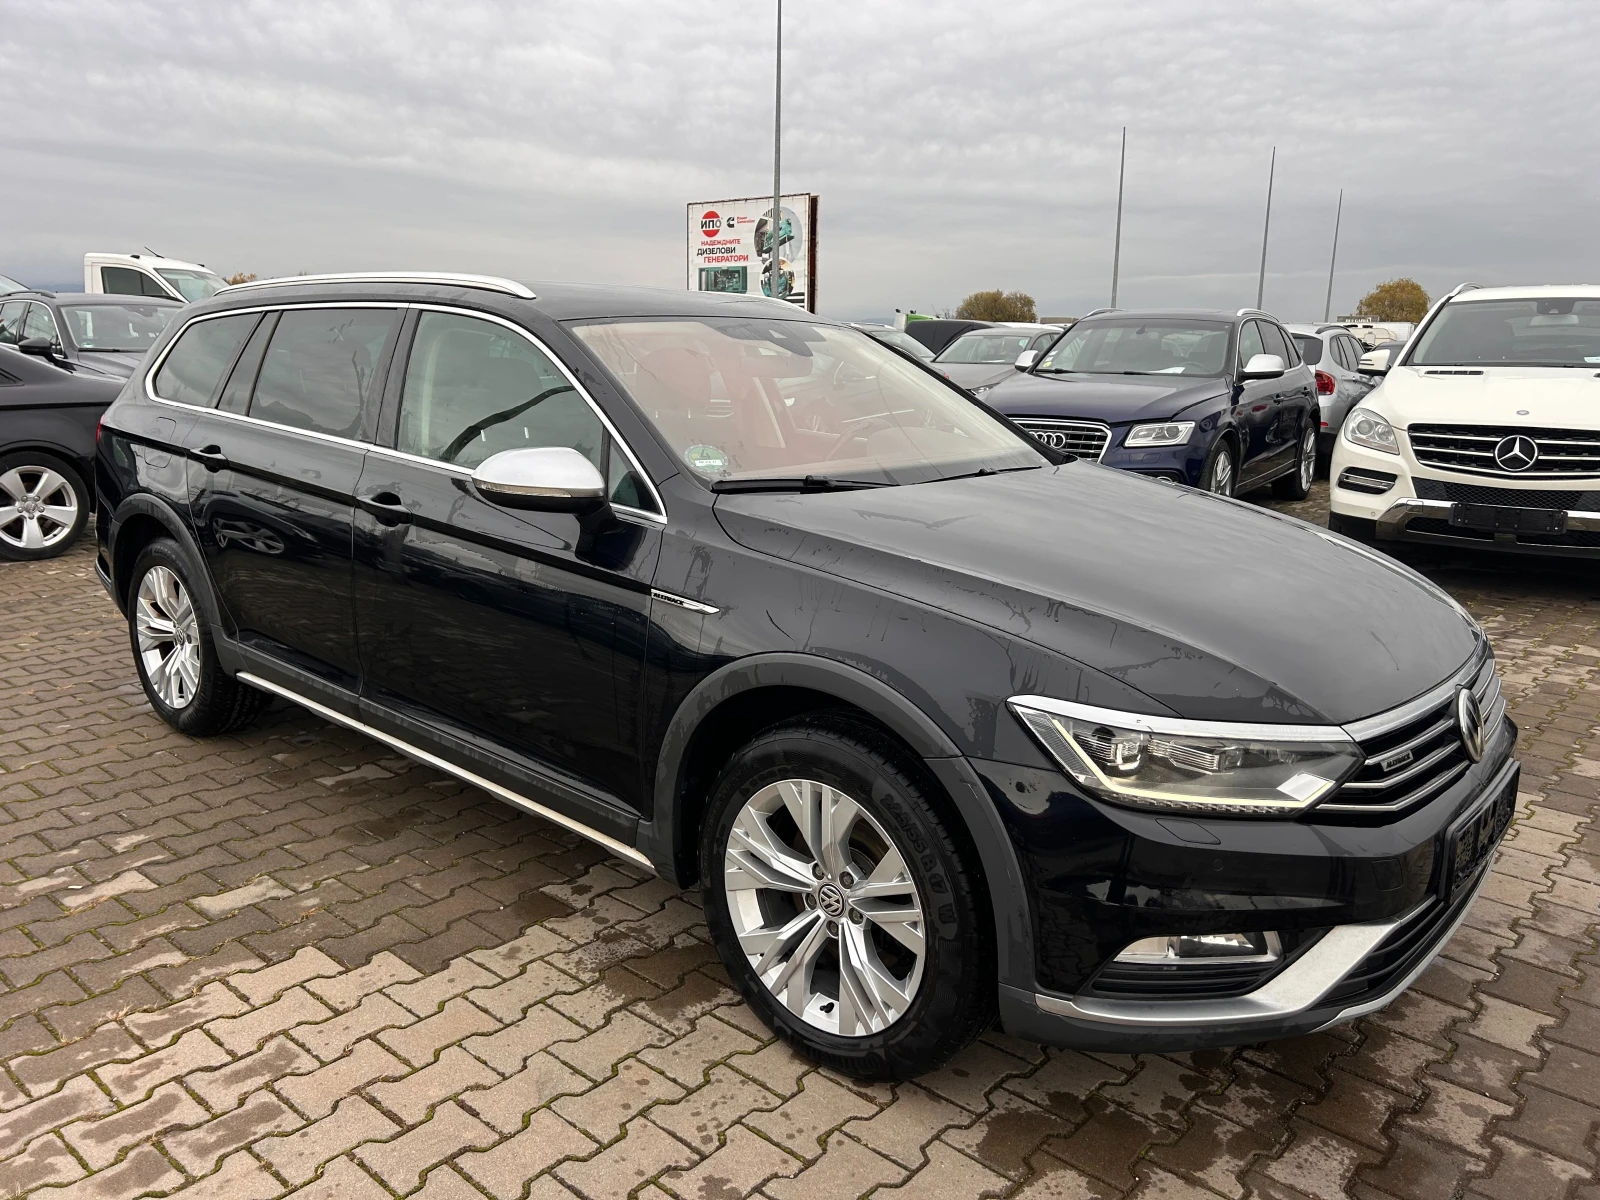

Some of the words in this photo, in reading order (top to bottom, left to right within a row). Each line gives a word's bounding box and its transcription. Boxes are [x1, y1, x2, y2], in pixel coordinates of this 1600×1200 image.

[701, 219, 721, 229] ИПО
[697, 247, 735, 256] ДИЗЕЛОВИ
[704, 255, 748, 263] ГЕНЕРАТОРИ
